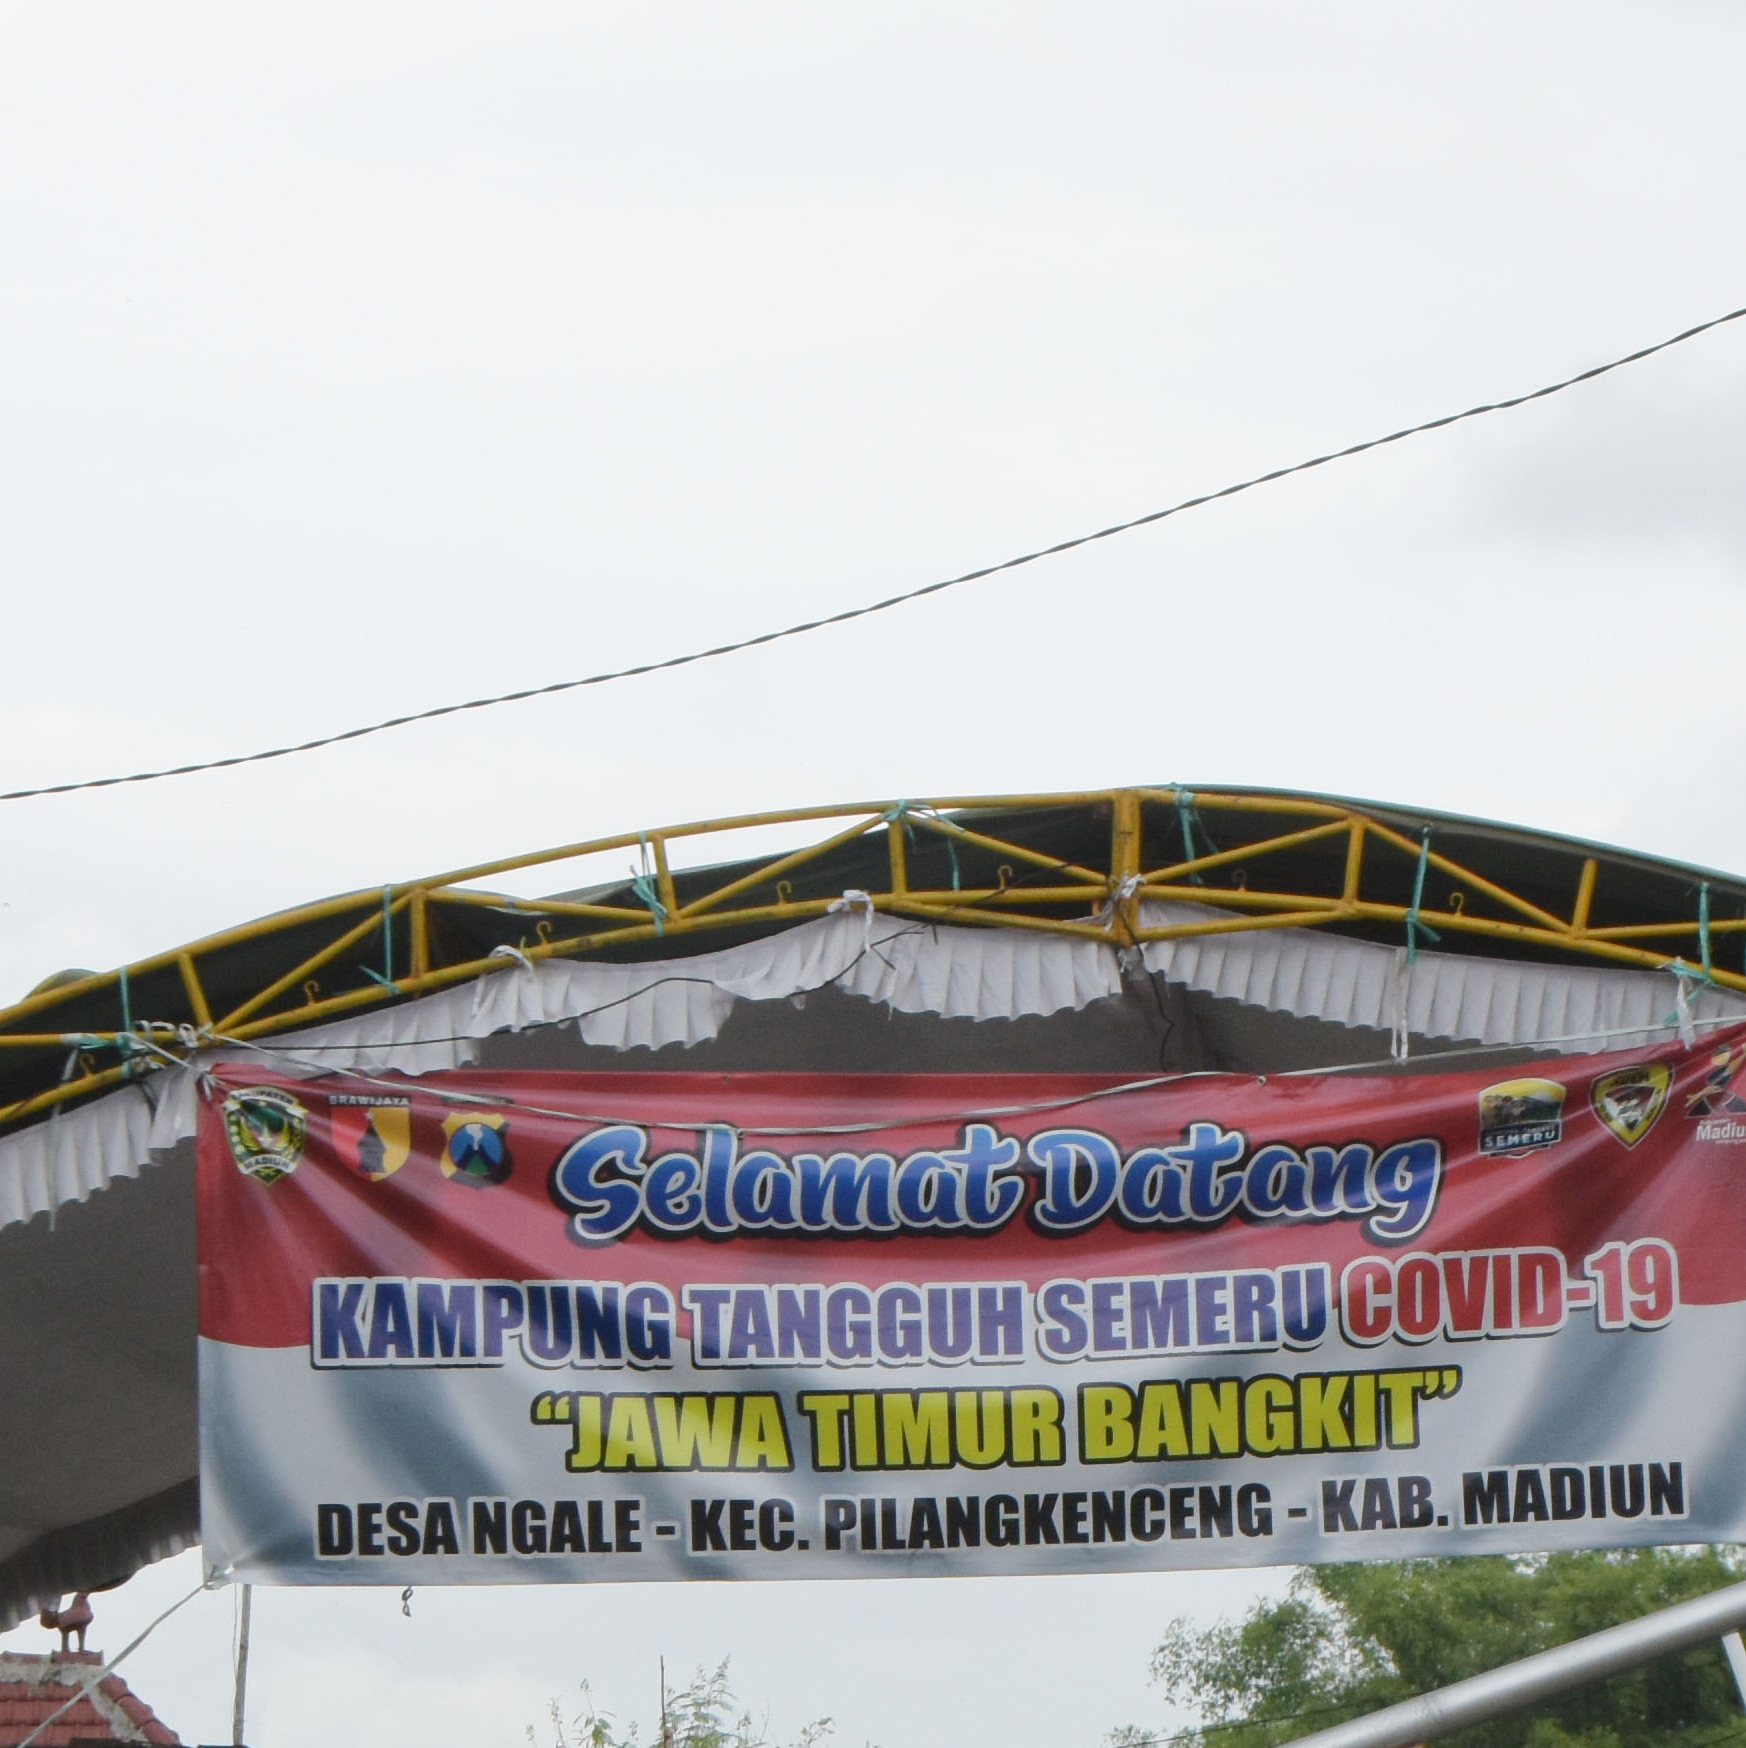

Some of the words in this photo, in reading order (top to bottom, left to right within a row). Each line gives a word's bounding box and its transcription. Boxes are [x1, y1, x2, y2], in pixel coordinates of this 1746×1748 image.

[329, 1095, 410, 1107] BRAWIJAYA
[1484, 1130, 1557, 1149] SEMERU
[556, 1122, 1024, 1240] Selamat
[1029, 1121, 1446, 1241] Datang
[314, 1280, 675, 1366] KAMPUNG
[686, 1282, 1024, 1364] TANGGUH
[1038, 1266, 1329, 1355] SEMERU
[1343, 1240, 1678, 1341] COVID-19
[803, 1387, 1062, 1471] TIMUR
[315, 1500, 460, 1556] DESA
[473, 1499, 644, 1554] NGALE
[690, 1498, 810, 1552] KEC.
[833, 1484, 1273, 1552] PILANGKENCENG
[1320, 1477, 1449, 1533] KAB.
[1463, 1461, 1686, 1525] MADIUN
